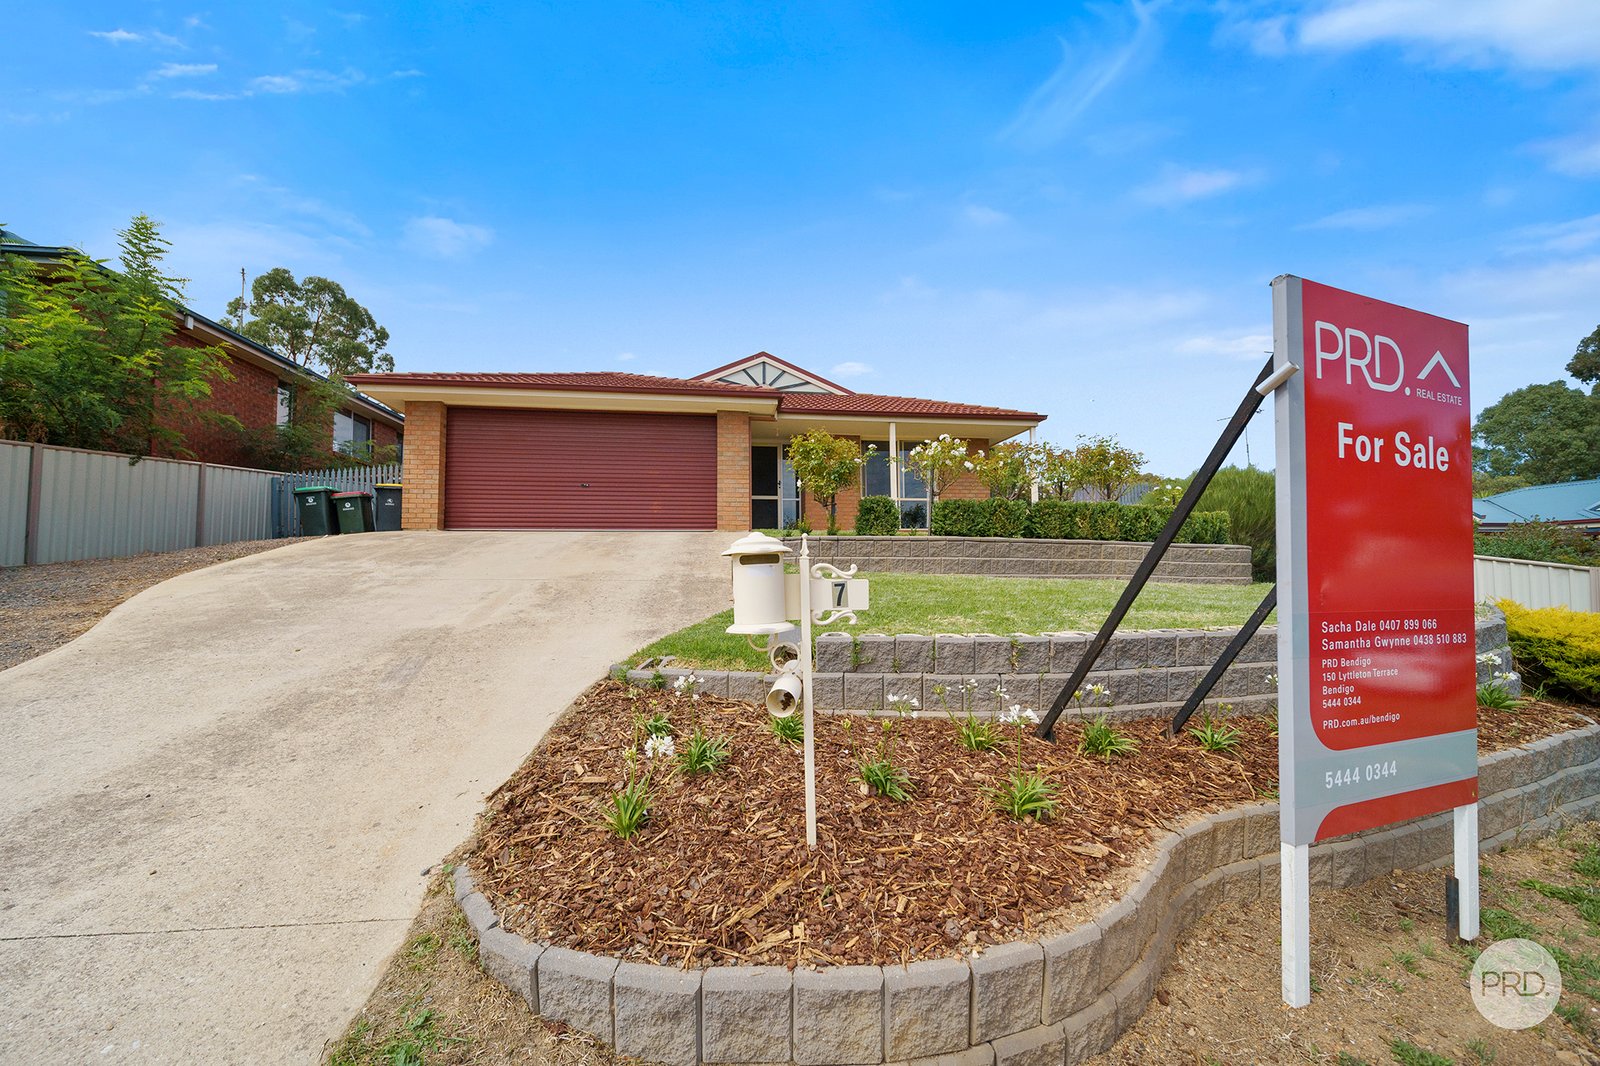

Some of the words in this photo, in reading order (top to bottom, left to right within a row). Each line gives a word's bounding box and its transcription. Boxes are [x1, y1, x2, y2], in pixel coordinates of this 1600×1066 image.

[1416, 388, 1435, 401] REAL
[1437, 391, 1462, 406] ESTATE
[1337, 421, 1384, 463] For
[1394, 430, 1449, 472] Sale
[834, 582, 846, 607] 7
[1321, 621, 1352, 633] Sacha
[1355, 620, 1376, 632] Dale
[1379, 620, 1401, 631] 0407
[1403, 619, 1419, 630] 899
[1422, 619, 1437, 630] 066
[1321, 637, 1371, 651] Samantha
[1374, 635, 1411, 649] Gwynne
[1413, 634, 1434, 646] 0438
[1436, 633, 1450, 644] 510
[1452, 633, 1467, 644] 883
[1322, 658, 1338, 668] PRD
[1340, 657, 1371, 668] Bendigo
[1322, 671, 1336, 682] 150
[1338, 669, 1372, 682] Lyttleton
[1373, 668, 1398, 678] Terrace
[1322, 684, 1355, 695] Bendigo
[1322, 697, 1341, 709] 5444
[1343, 695, 1361, 706] 0344
[1322, 712, 1400, 730] PRD.com.au/bendigo
[1325, 767, 1360, 789] 5444
[1365, 760, 1398, 781] 0344
